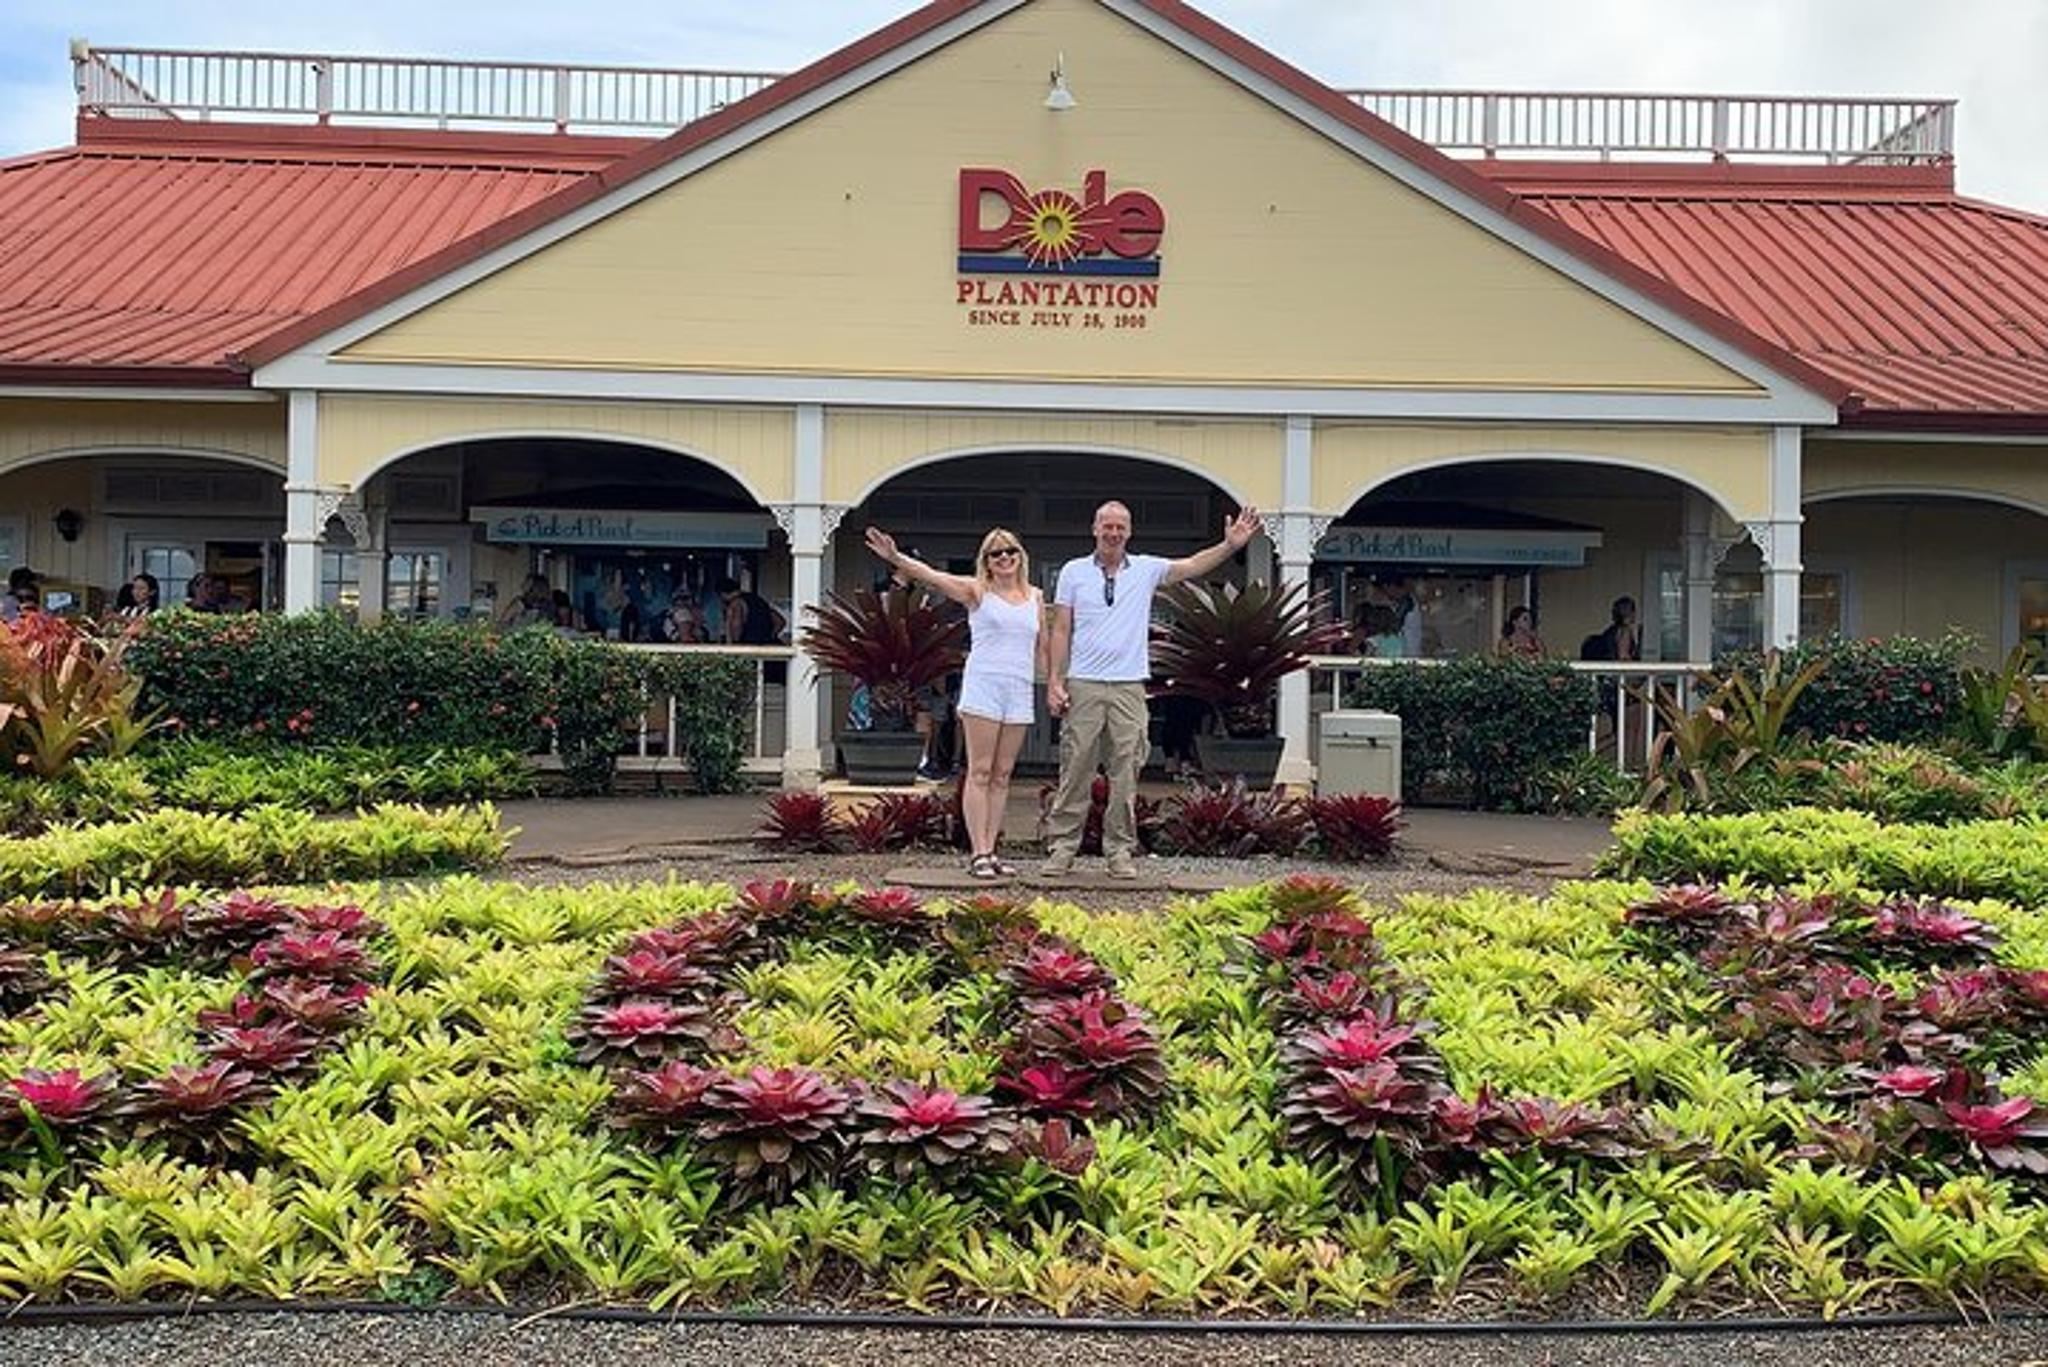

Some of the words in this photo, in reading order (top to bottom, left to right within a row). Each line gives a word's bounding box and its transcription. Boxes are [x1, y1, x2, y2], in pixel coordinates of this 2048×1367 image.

[958, 167, 1166, 263] Dole
[956, 280, 1160, 308] PLANTATION
[968, 309, 1021, 326] SINCE
[1030, 311, 1074, 328] JULY
